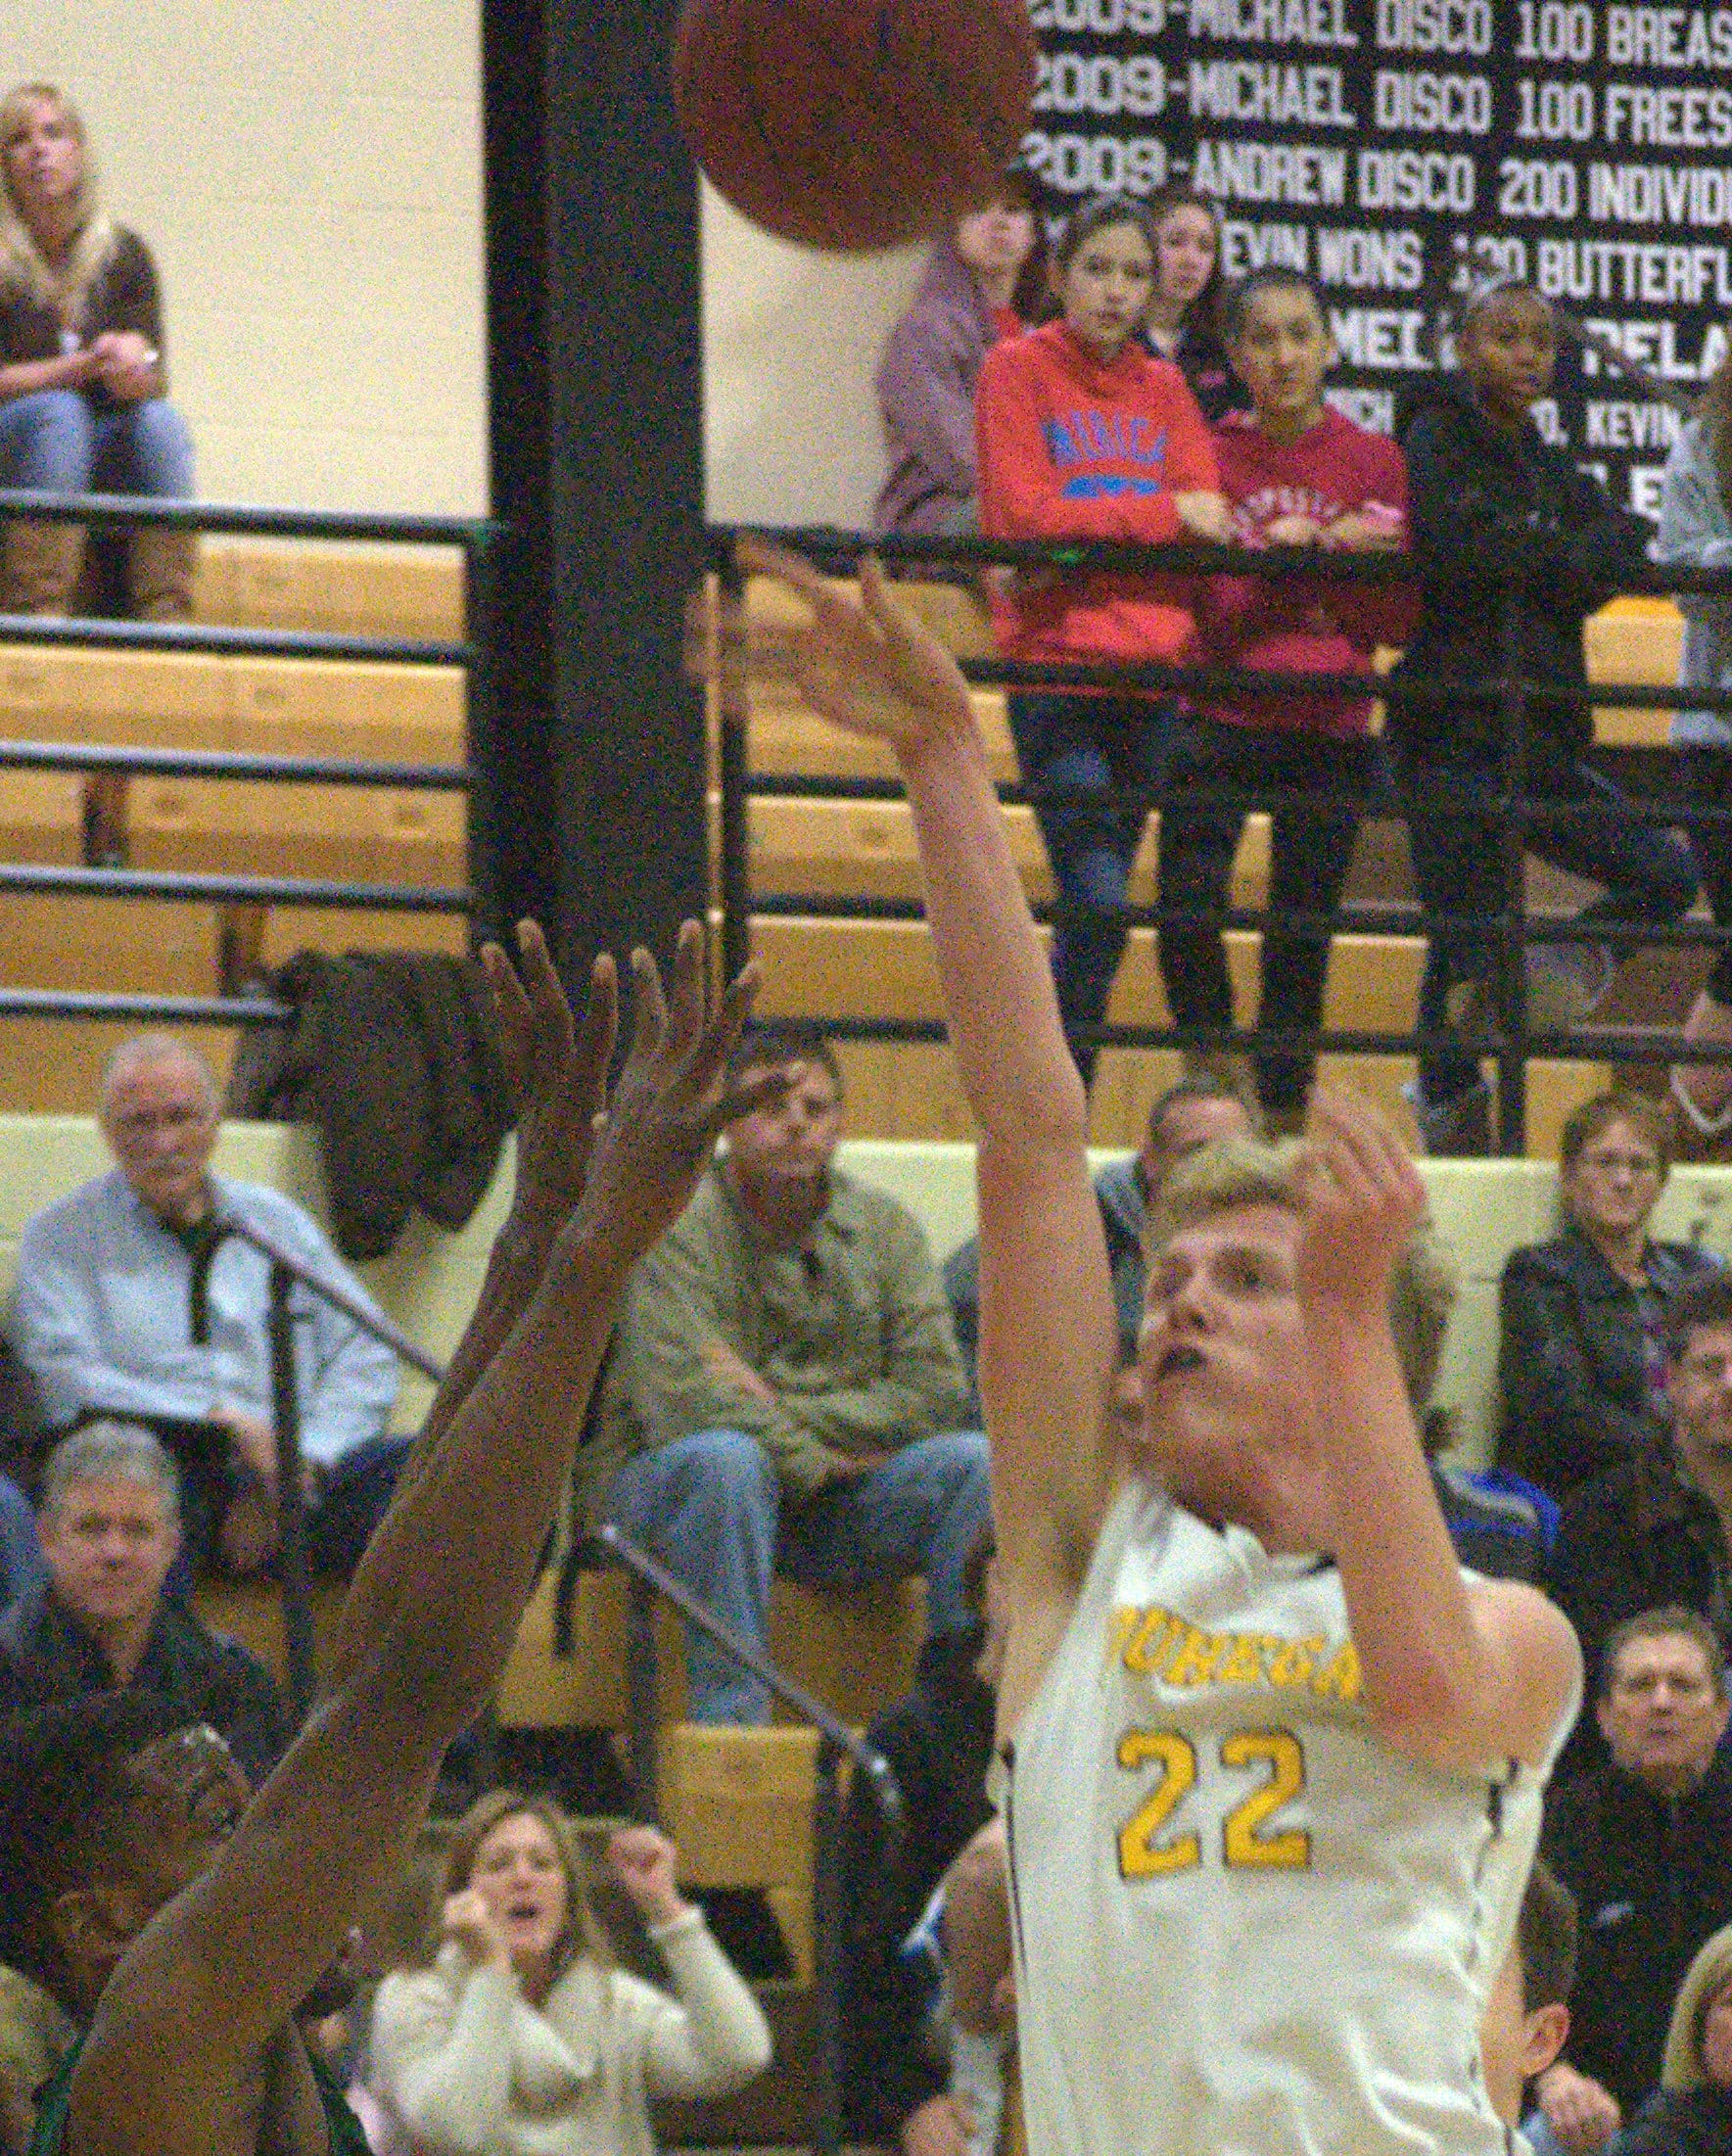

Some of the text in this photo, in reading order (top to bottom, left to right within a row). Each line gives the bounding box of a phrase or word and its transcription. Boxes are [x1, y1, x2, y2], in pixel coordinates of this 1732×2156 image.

[1376, 0, 1492, 55] DISCO
[1517, 2, 1594, 62] 100
[1607, 7, 1732, 67] BREAS
[1375, 70, 1492, 135] DISCO
[1517, 79, 1594, 141] 100
[1606, 83, 1732, 146] FREES
[1359, 150, 1475, 212] DISCO
[1499, 158, 1578, 218] 200
[1317, 226, 1425, 290] WONS
[1116, 1723, 1312, 1884] 22
